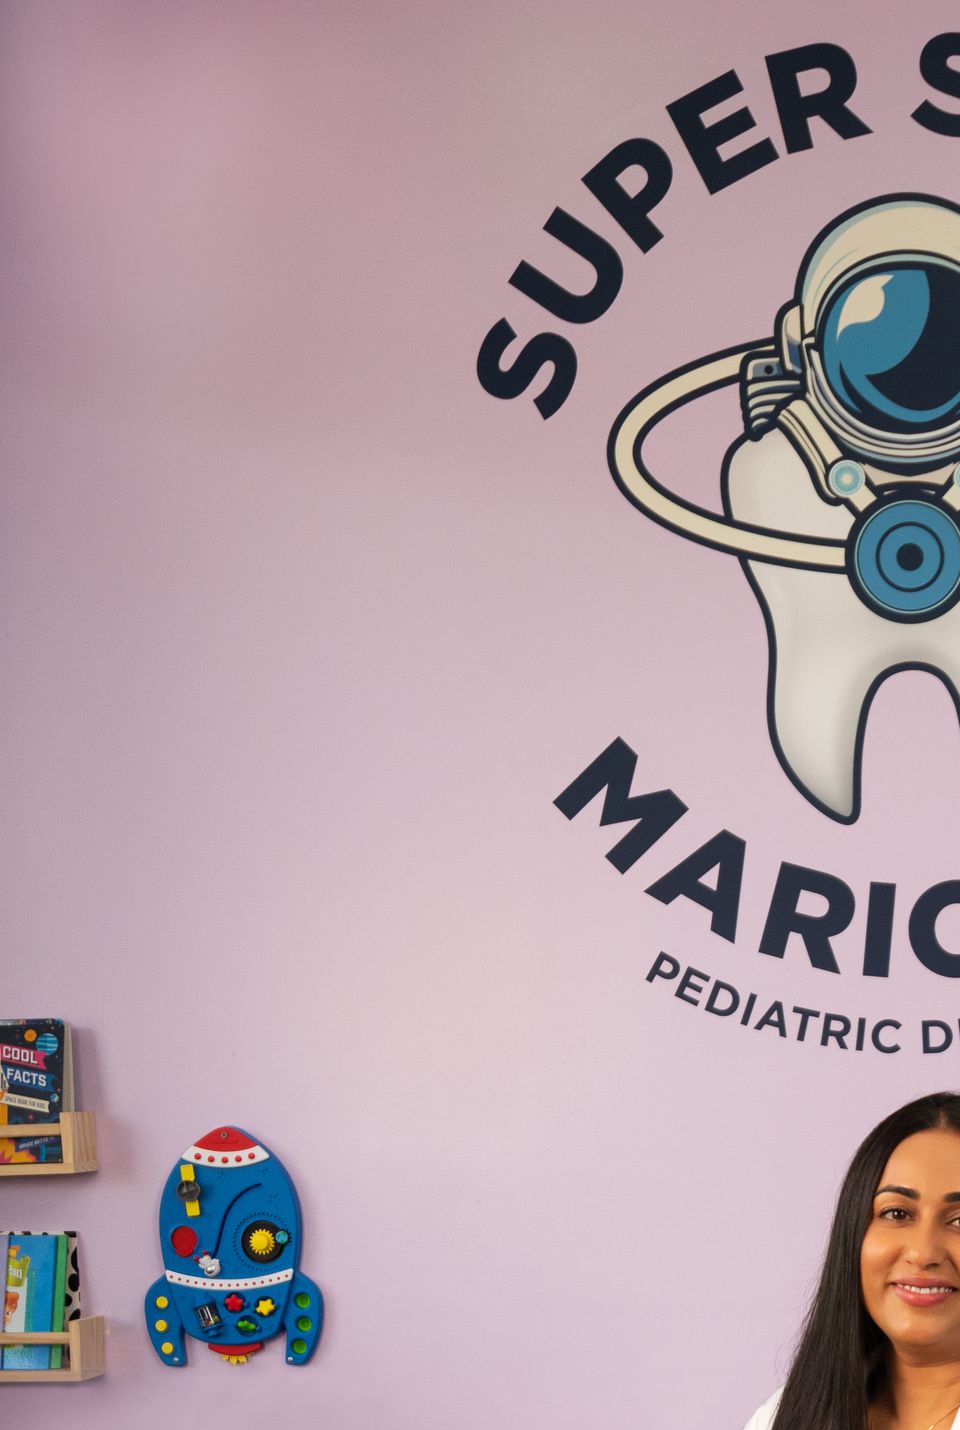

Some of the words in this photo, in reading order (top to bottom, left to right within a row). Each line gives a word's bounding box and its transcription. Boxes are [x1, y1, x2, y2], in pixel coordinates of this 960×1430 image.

[476, 42, 874, 420] SUPER
[645, 950, 901, 1055] PEDIATRIC
[2, 1045, 38, 1064] COOL
[6, 1067, 47, 1087] FACTS
